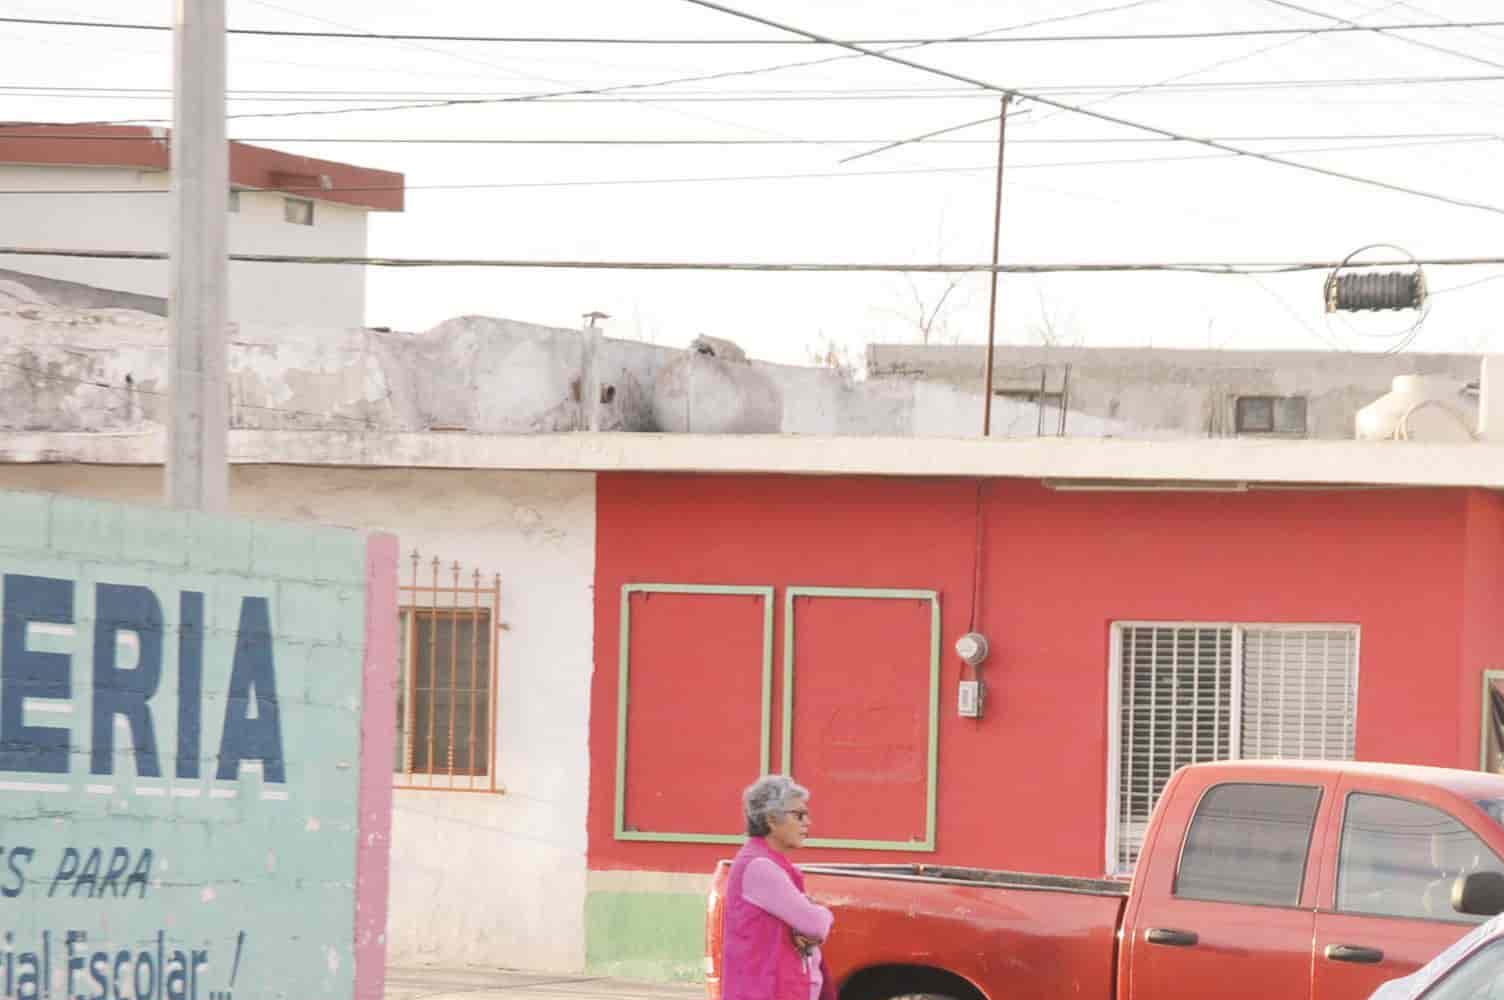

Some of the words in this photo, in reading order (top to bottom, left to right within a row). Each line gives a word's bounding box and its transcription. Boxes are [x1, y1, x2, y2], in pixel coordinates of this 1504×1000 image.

[0, 572, 287, 785] ERIA
[0, 846, 36, 898] S
[48, 846, 153, 900] PARA
